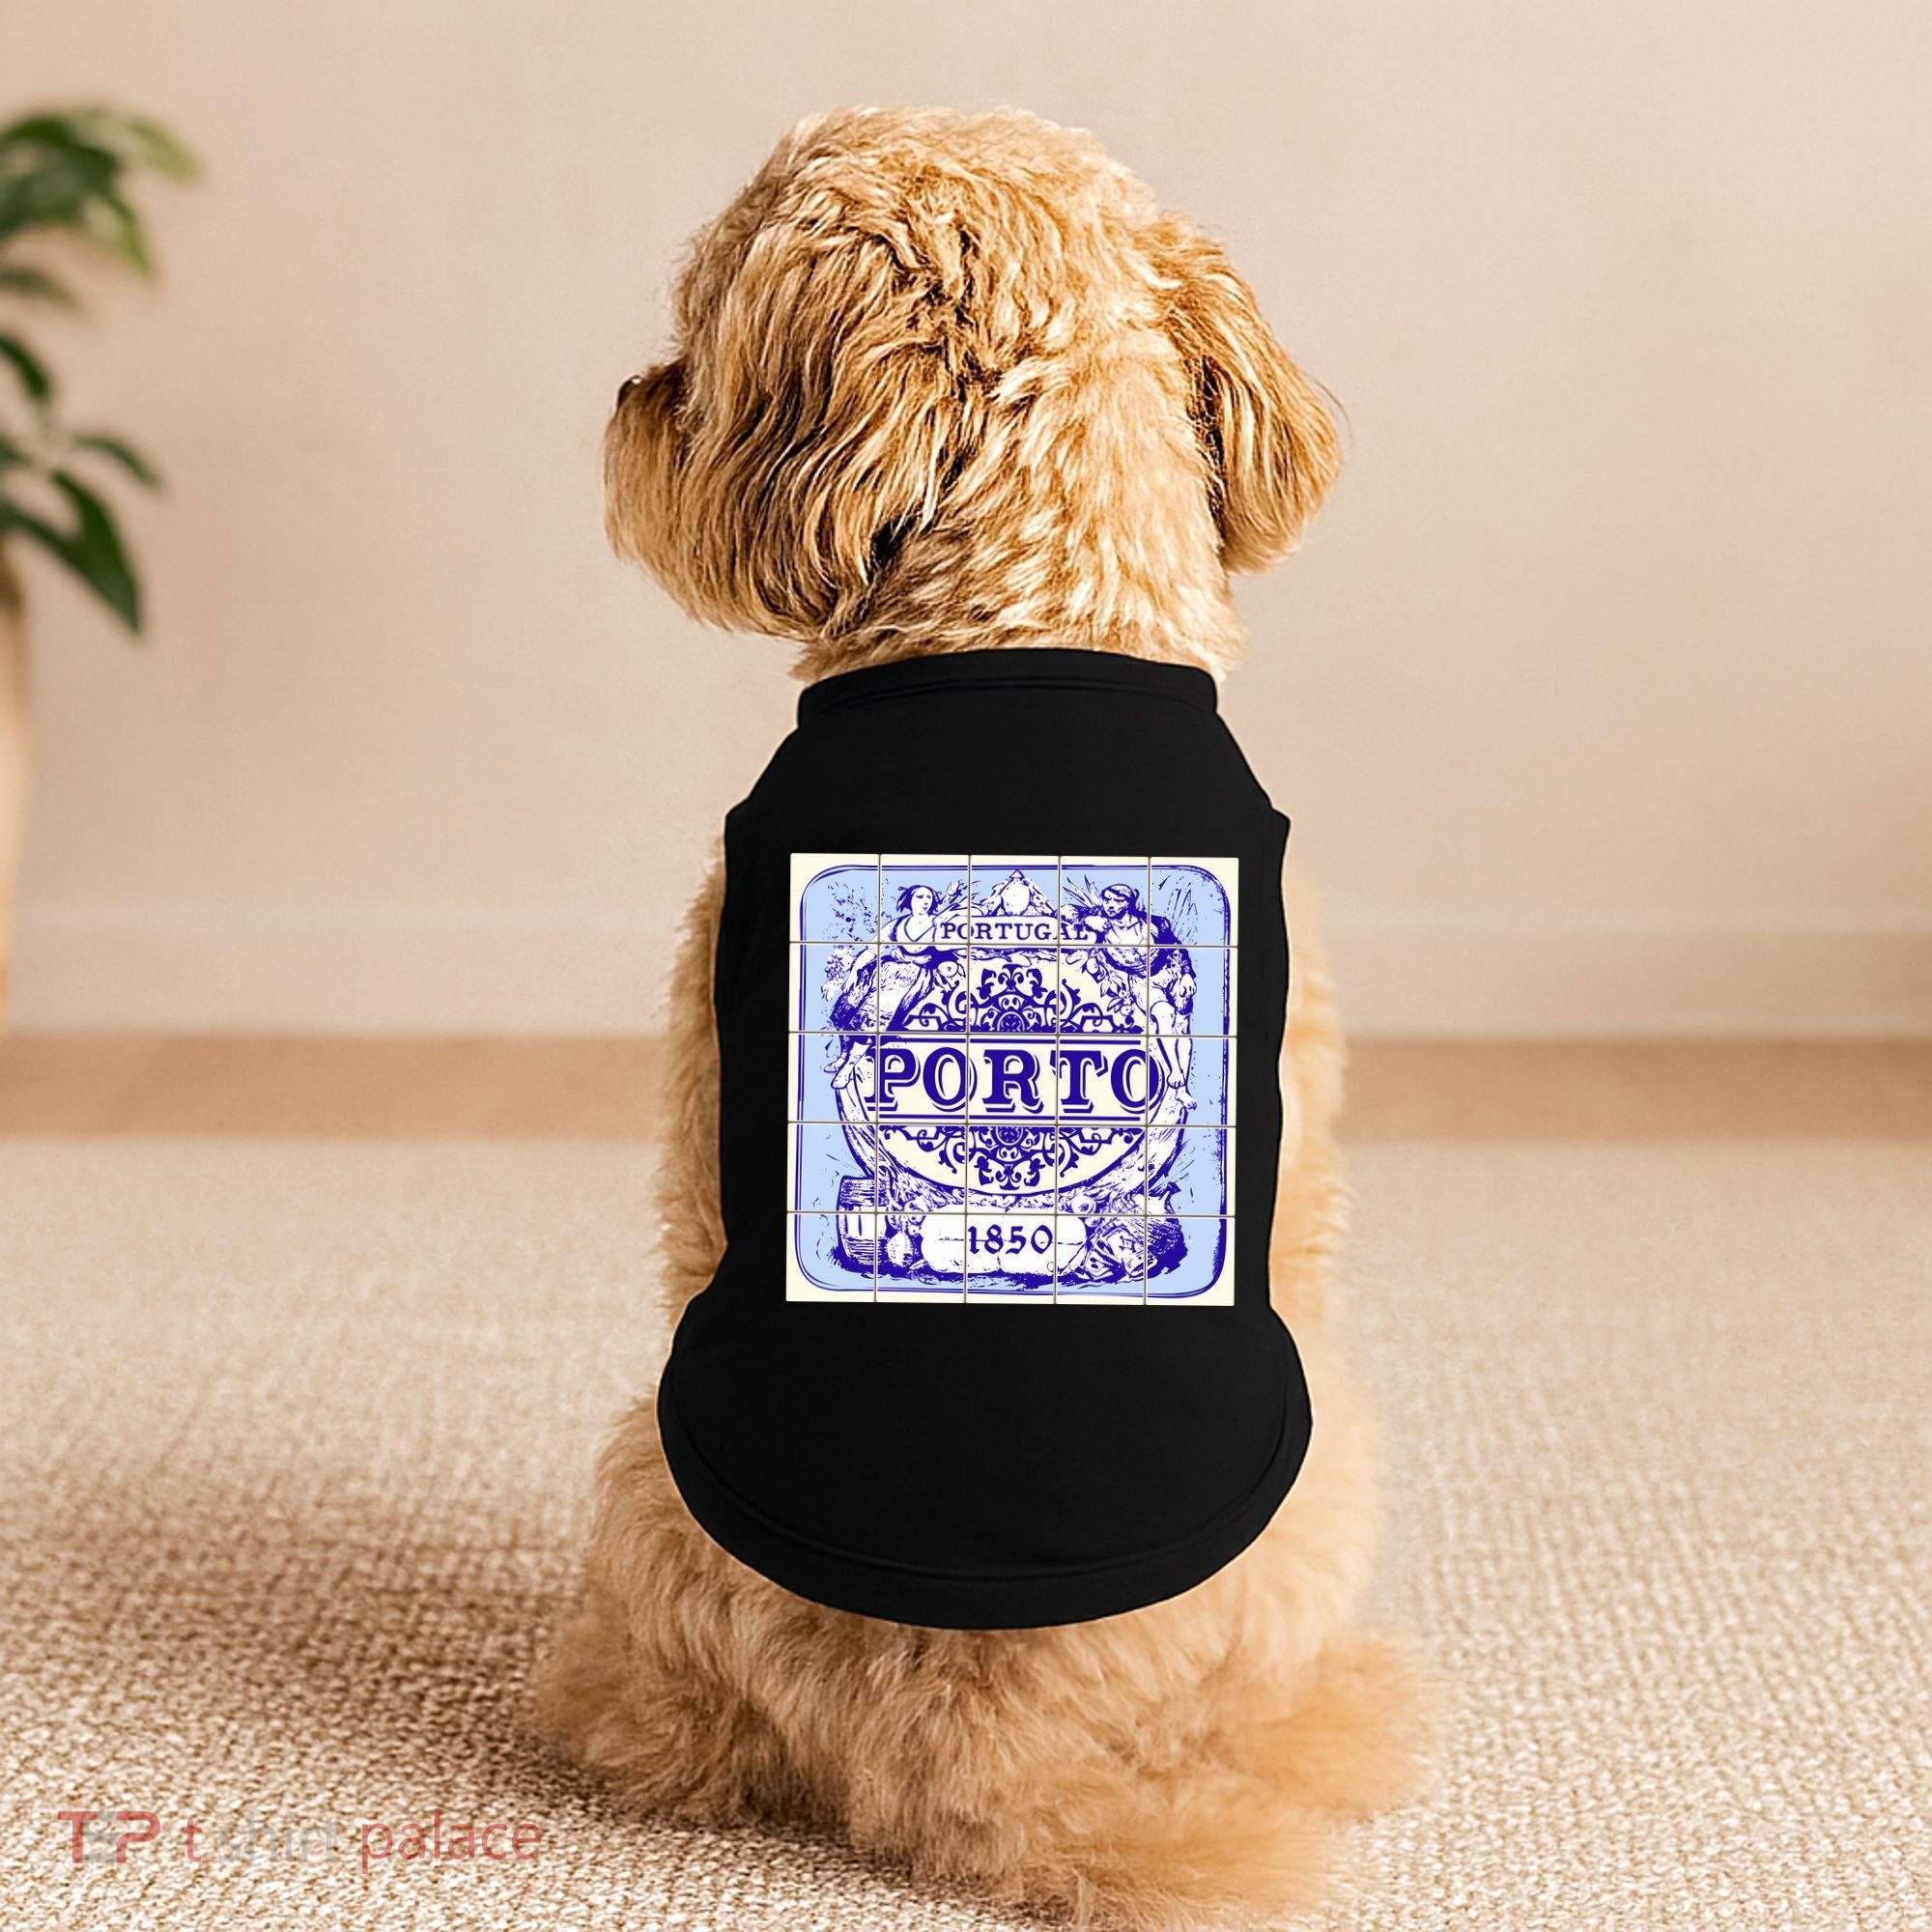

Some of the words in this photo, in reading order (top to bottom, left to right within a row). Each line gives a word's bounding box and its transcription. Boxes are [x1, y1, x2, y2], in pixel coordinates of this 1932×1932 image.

[940, 922, 1089, 941] PORTUGAL
[865, 1046, 1165, 1114] PORTO
[968, 1224, 1054, 1255] 1850
